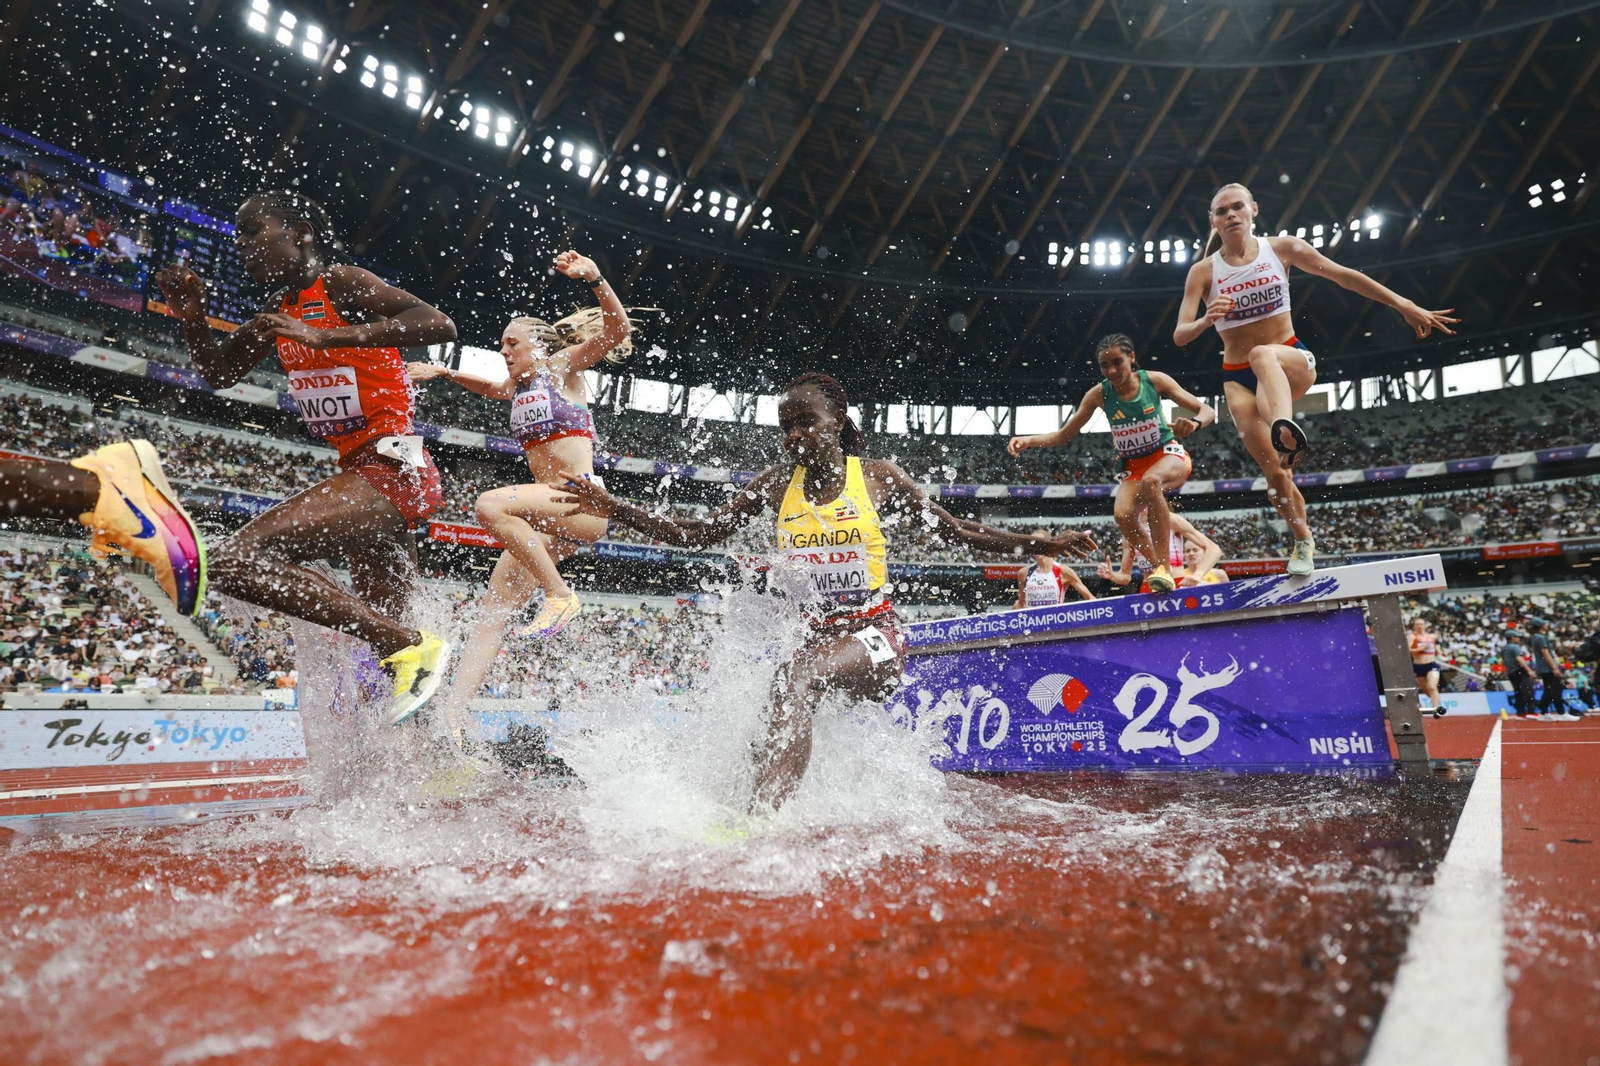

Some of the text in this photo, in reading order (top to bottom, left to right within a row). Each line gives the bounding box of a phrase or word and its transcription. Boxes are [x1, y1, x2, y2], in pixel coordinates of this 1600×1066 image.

[1220, 275, 1281, 294] HONDA
[290, 374, 355, 391] ONDA
[299, 395, 352, 418] IWOT
[513, 393, 547, 410] NDA
[1113, 422, 1157, 438] HONDA
[1116, 431, 1159, 450] WALLE
[782, 528, 862, 549] UGANDA
[787, 551, 864, 565] ONDA
[1384, 568, 1435, 586] NISHI
[907, 606, 1114, 641] WORLD ATHLETICS CHAMPIONSHIPS
[1112, 651, 1244, 756] 25
[1421, 698, 1458, 710] Toyo
[1020, 720, 1104, 733] WORLD ATHLETICS
[44, 718, 247, 761] Tokyo Tokyo
[1020, 730, 1105, 743] CHAMPIONSHIPS
[1309, 736, 1374, 755] NISHI
